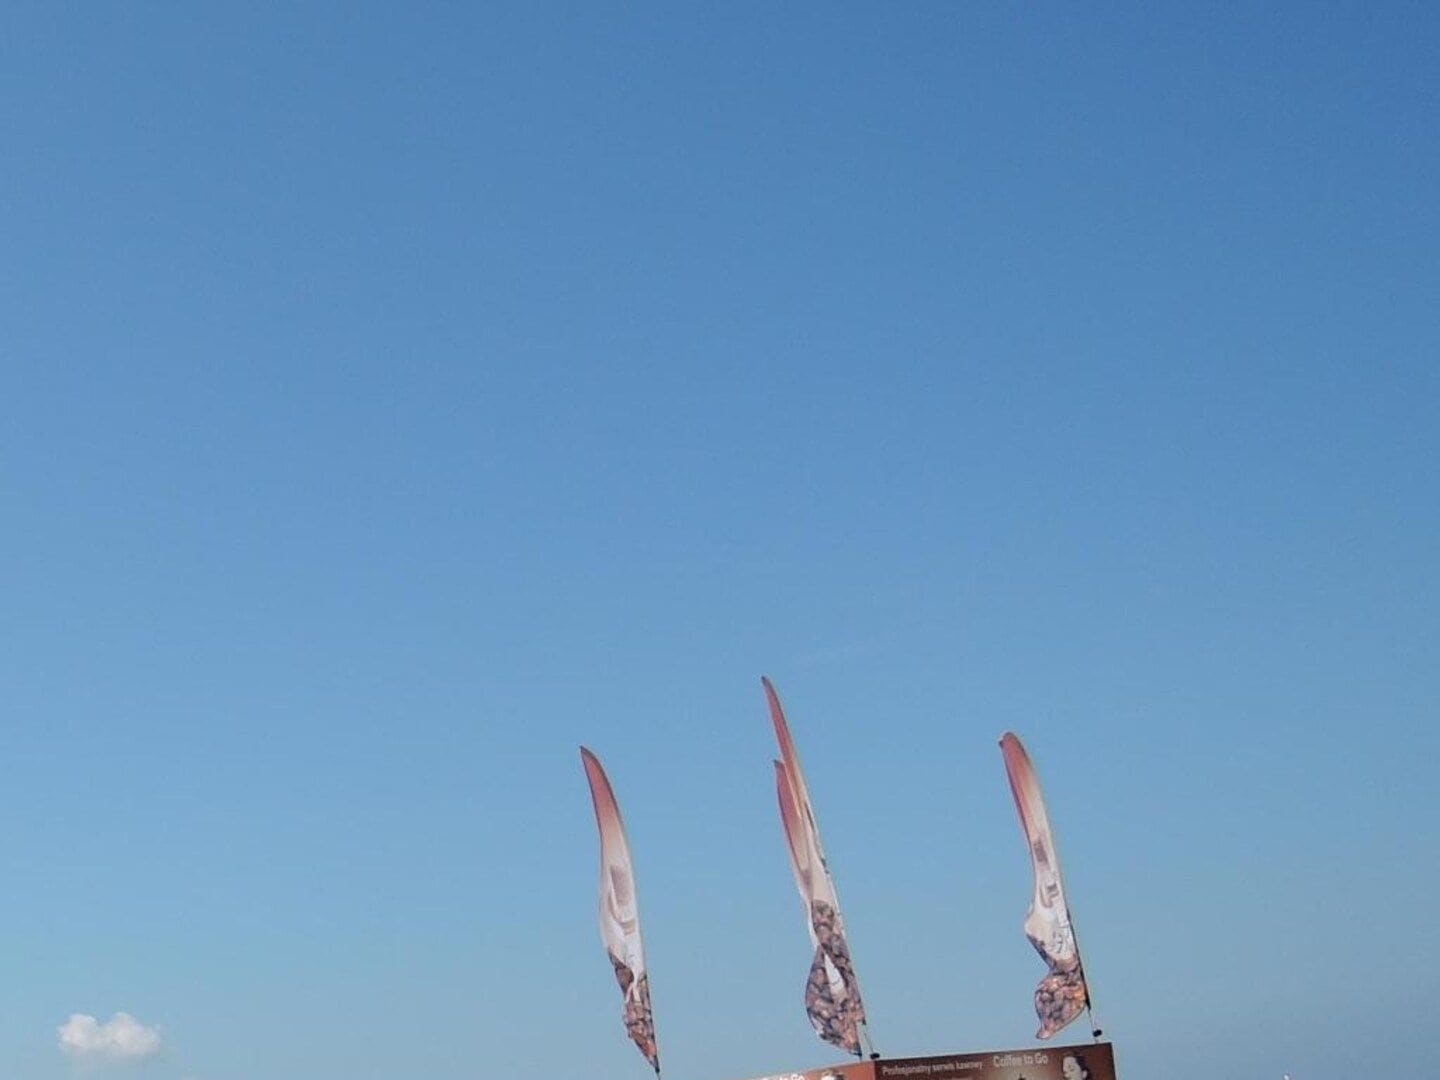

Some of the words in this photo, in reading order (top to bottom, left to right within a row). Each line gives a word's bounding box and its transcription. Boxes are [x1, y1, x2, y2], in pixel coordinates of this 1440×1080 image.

[993, 1054, 1023, 1068] Coffee
[1024, 1053, 1034, 1066] to
[1036, 1052, 1048, 1064] Go
